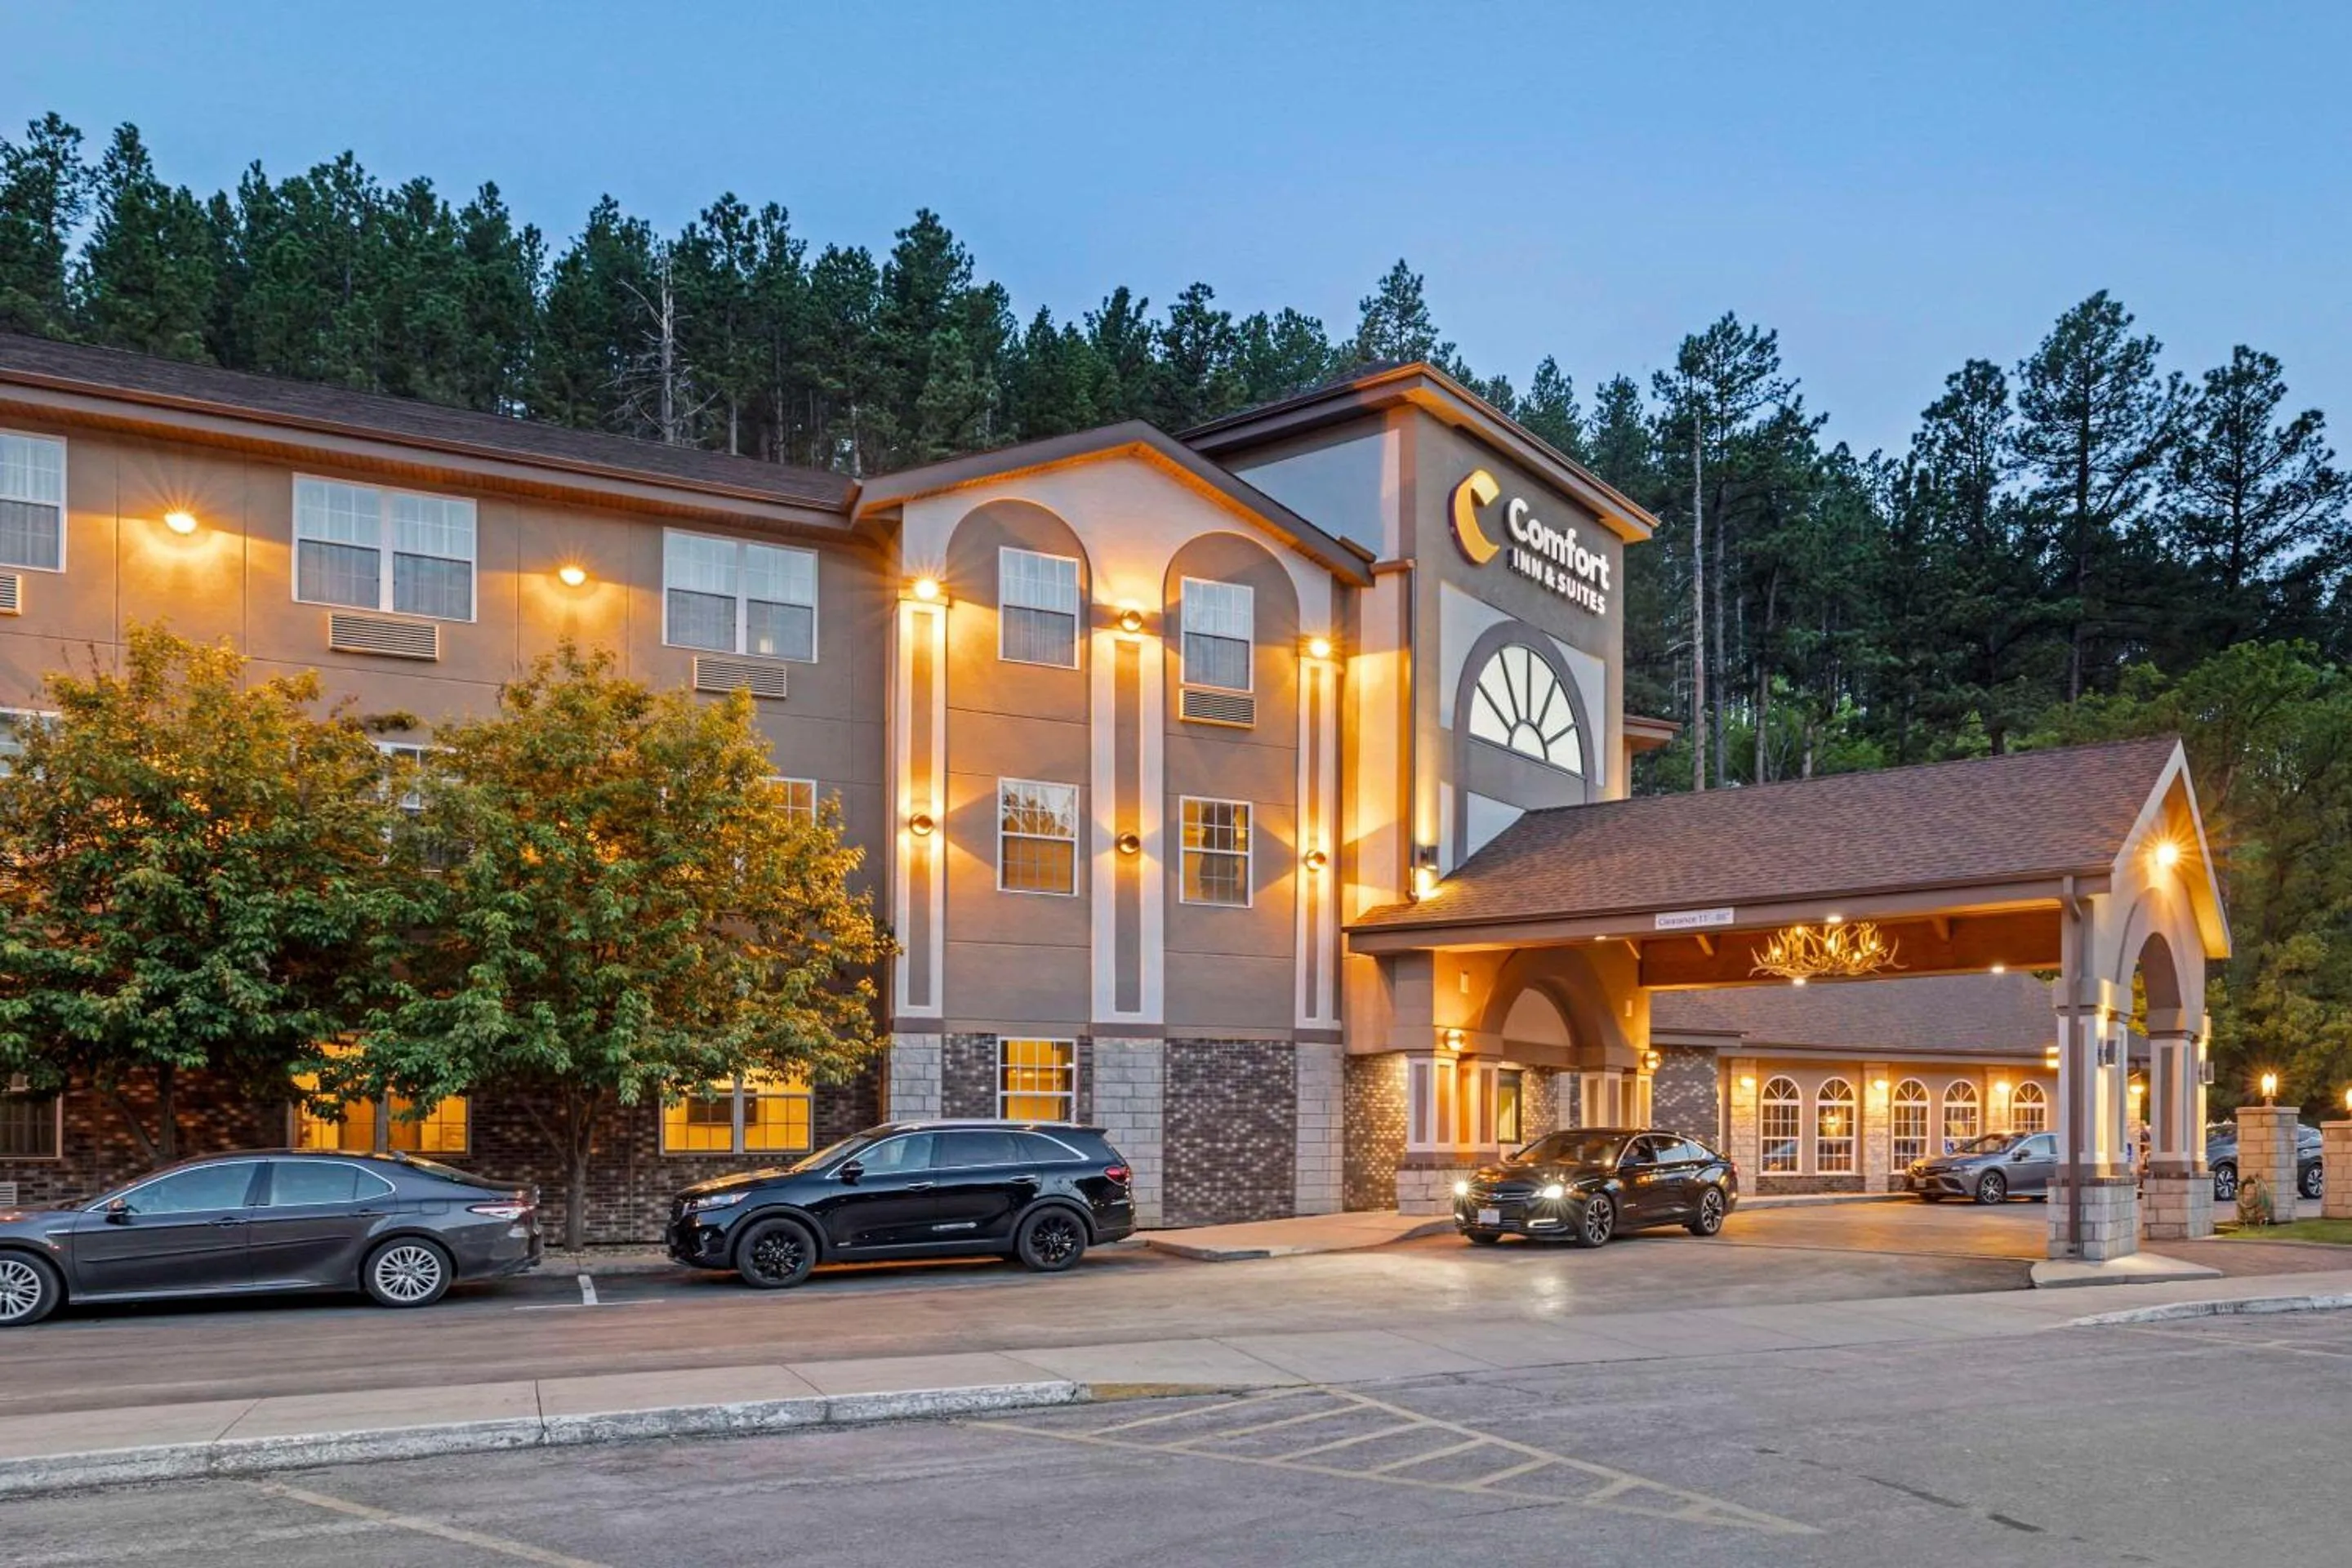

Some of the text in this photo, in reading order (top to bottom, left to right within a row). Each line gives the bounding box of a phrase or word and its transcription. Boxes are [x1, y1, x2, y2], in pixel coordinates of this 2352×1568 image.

[1508, 497, 1610, 590] Comfort
[1513, 548, 1606, 614] INN & SUITES
